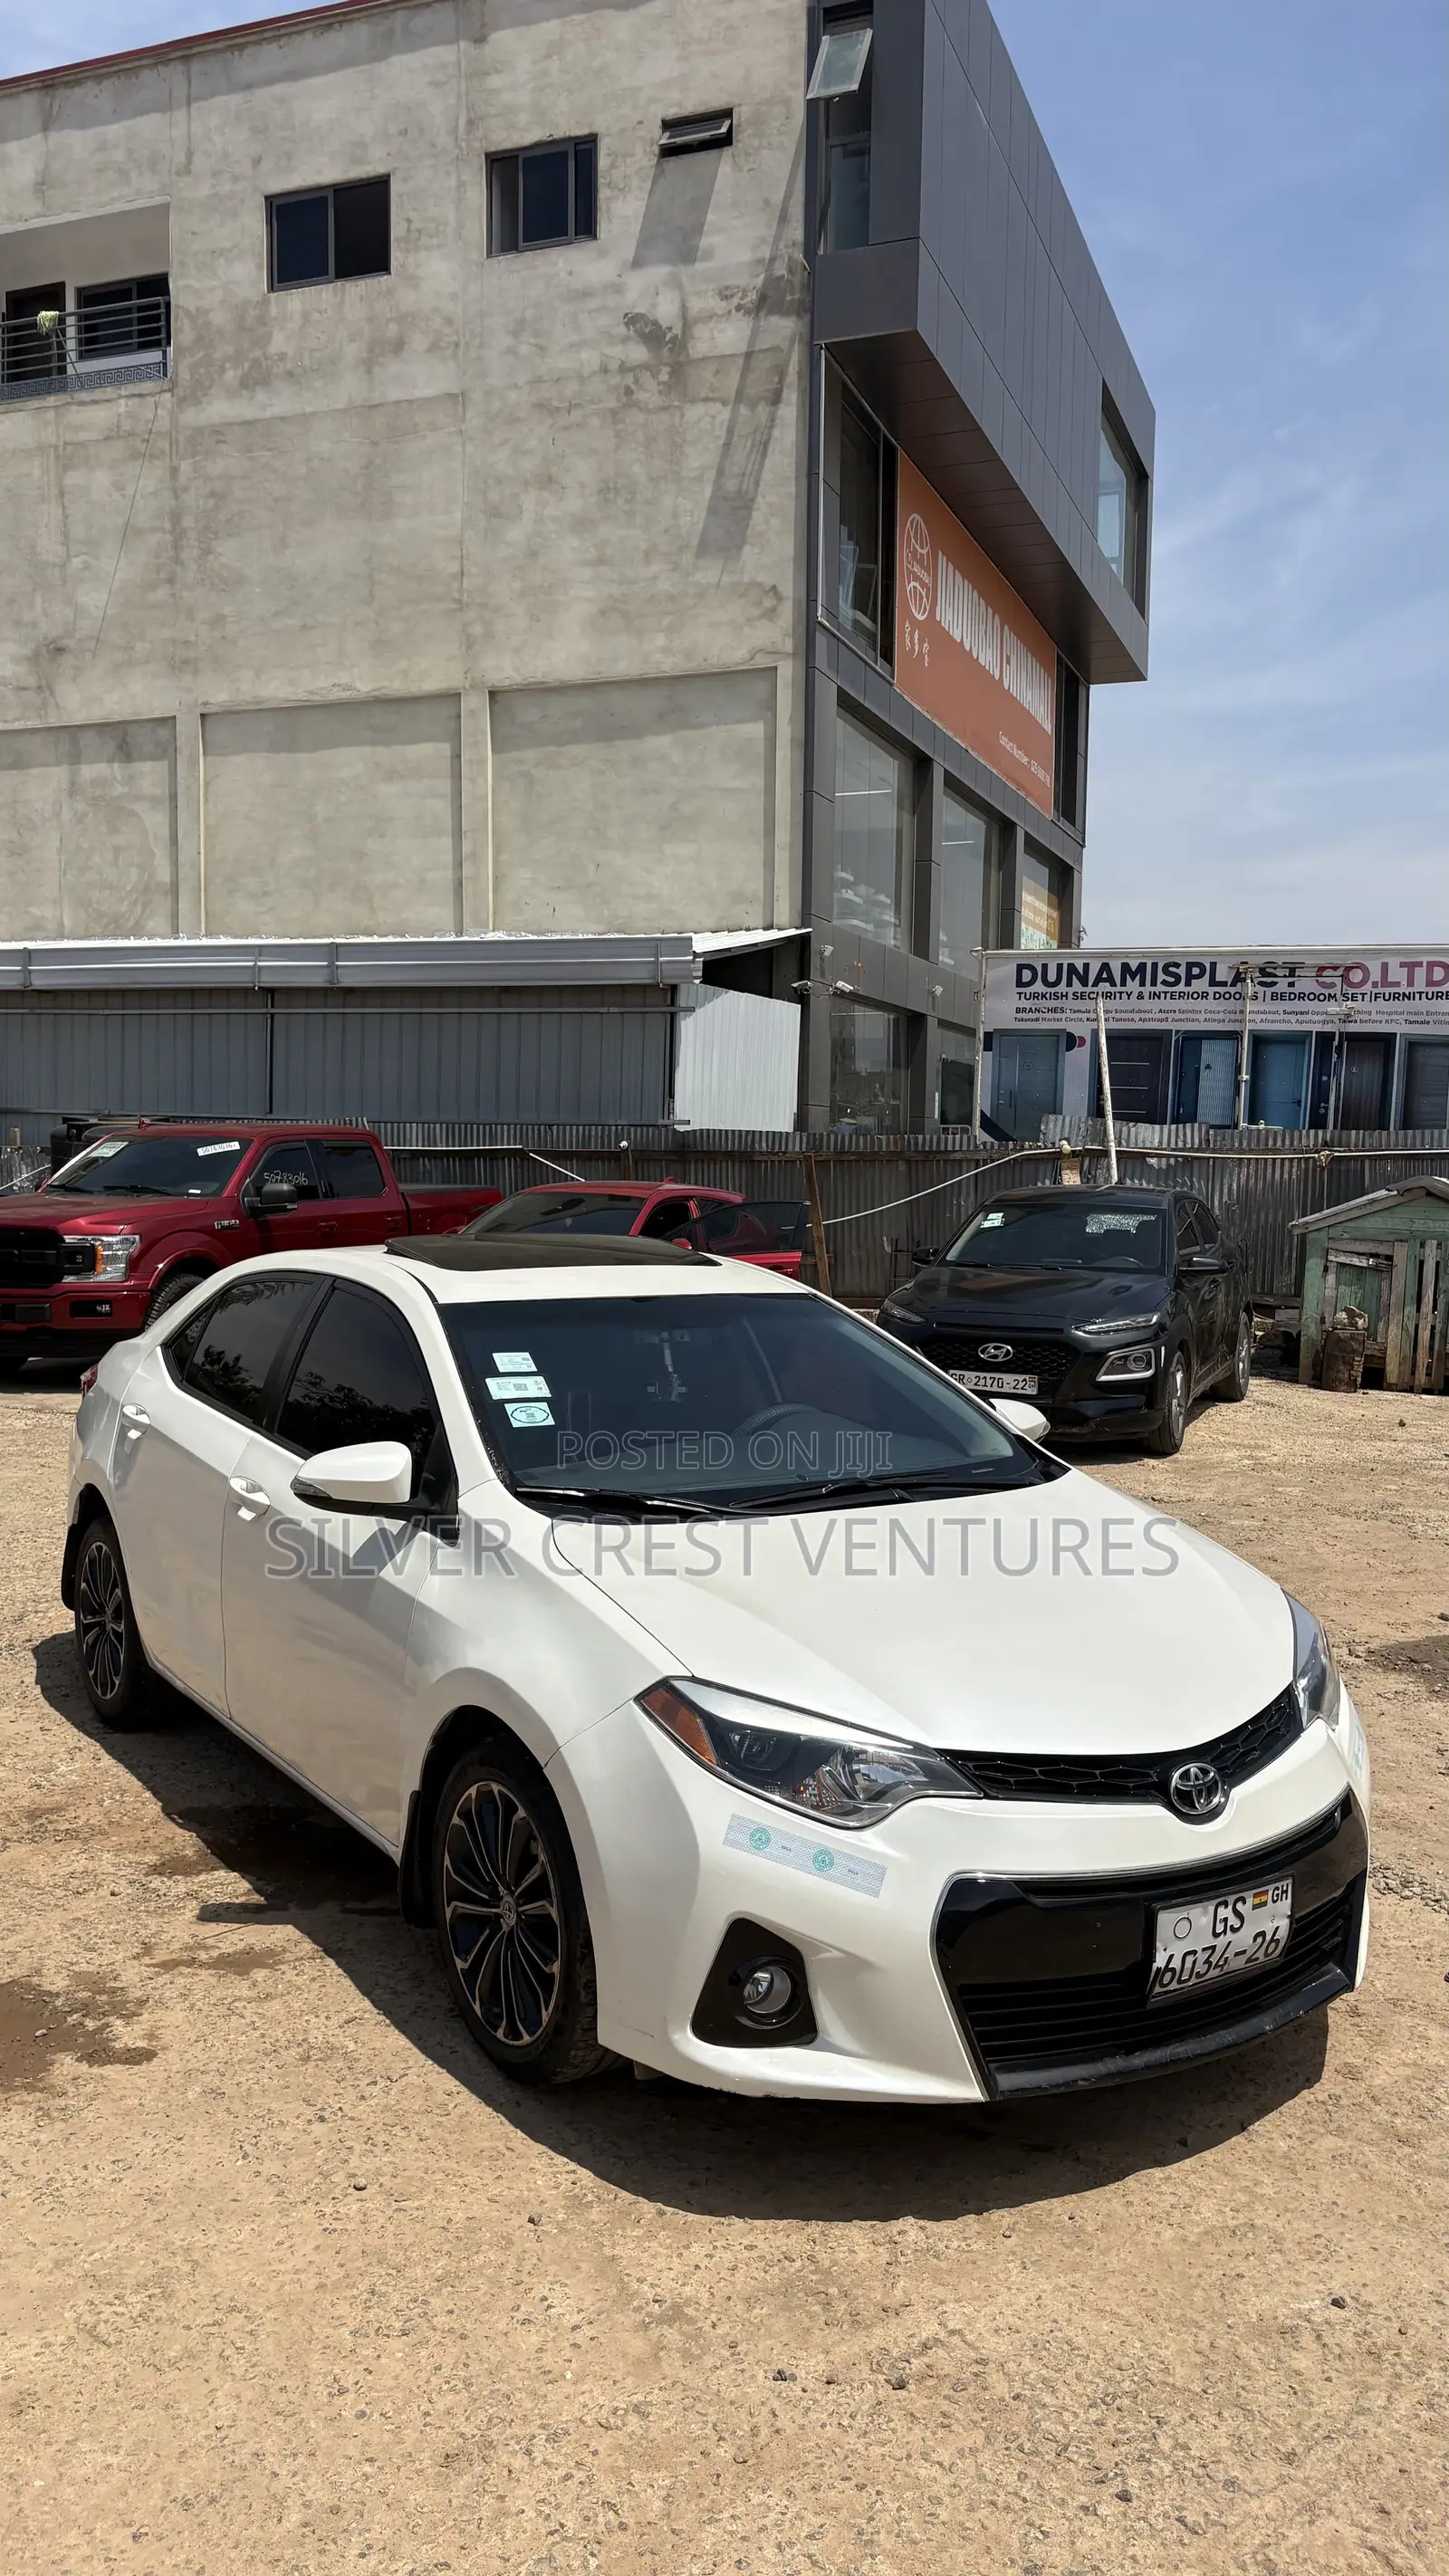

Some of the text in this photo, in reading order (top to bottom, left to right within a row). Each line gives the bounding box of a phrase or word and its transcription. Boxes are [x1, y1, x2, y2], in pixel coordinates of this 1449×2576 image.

[936, 550, 1051, 735] JIADUOBAO CHINAMALL
[1015, 960, 1449, 990] DUNAMISPLAST CO.LTD
[1016, 991, 1069, 1001] TURKISH
[1071, 991, 1133, 1001] SECURITY
[1136, 991, 1145, 1001] &
[1148, 991, 1210, 1001] INTERIOR
[1270, 991, 1338, 1002] BEDROOM
[1015, 1006, 1068, 1014] BRANCHES:
[264, 1170, 308, 1186] 50783016
[1271, 1882, 1290, 1905] GH
[1212, 1895, 1247, 1939] GS
[1156, 1925, 1281, 1989] 6034-26
